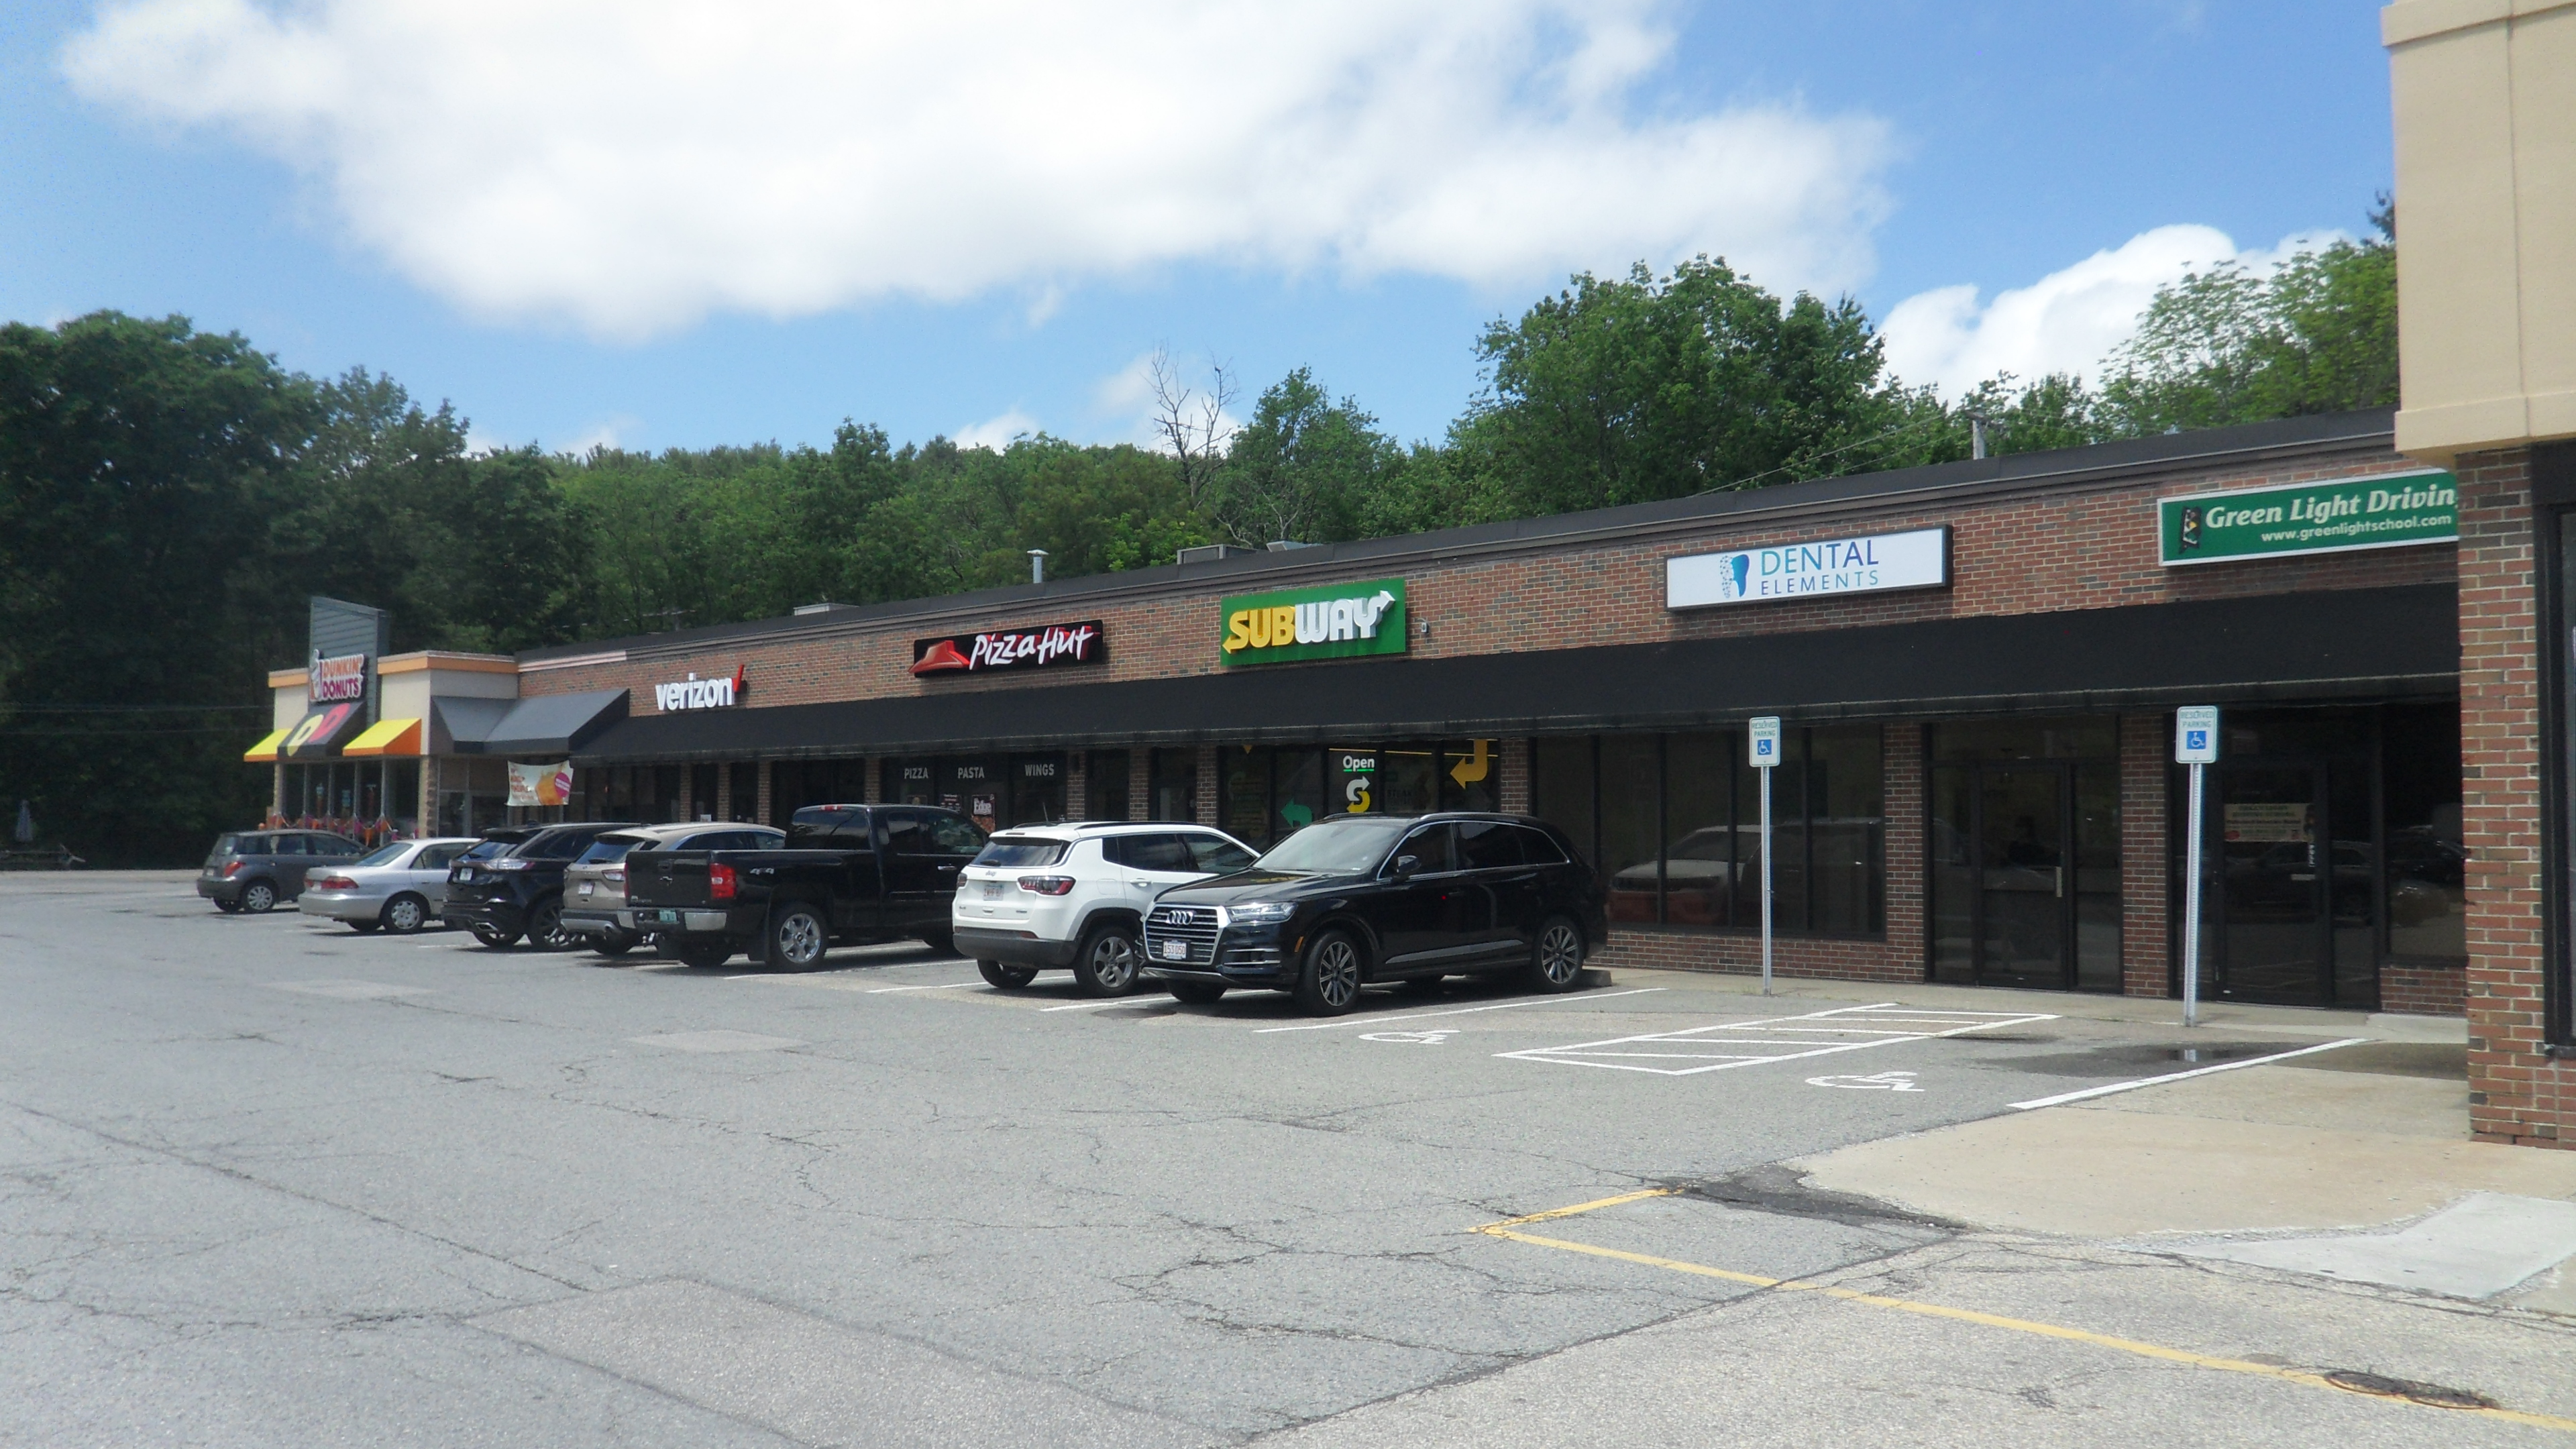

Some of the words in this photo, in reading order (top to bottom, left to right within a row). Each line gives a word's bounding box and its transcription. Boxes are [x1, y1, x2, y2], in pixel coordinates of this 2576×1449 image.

[2206, 505, 2282, 528] Green
[2290, 494, 2359, 524] Light
[2366, 484, 2458, 513] Drivin
[2261, 514, 2451, 541] www.greenlightschool.com
[1761, 539, 1879, 576] DENTAL
[1761, 570, 1878, 596] ELEMENTS
[1222, 590, 1395, 654] SUBWAY
[969, 633, 1037, 670] Pizza
[1038, 625, 1098, 664] Hut
[323, 678, 360, 699] DONUTS
[655, 673, 735, 710] verizon
[904, 767, 929, 779] PIZZA
[958, 767, 985, 778] PASTA
[1025, 763, 1055, 776] WINGS
[1343, 755, 1375, 771] Open
[974, 800, 991, 814] Edge
